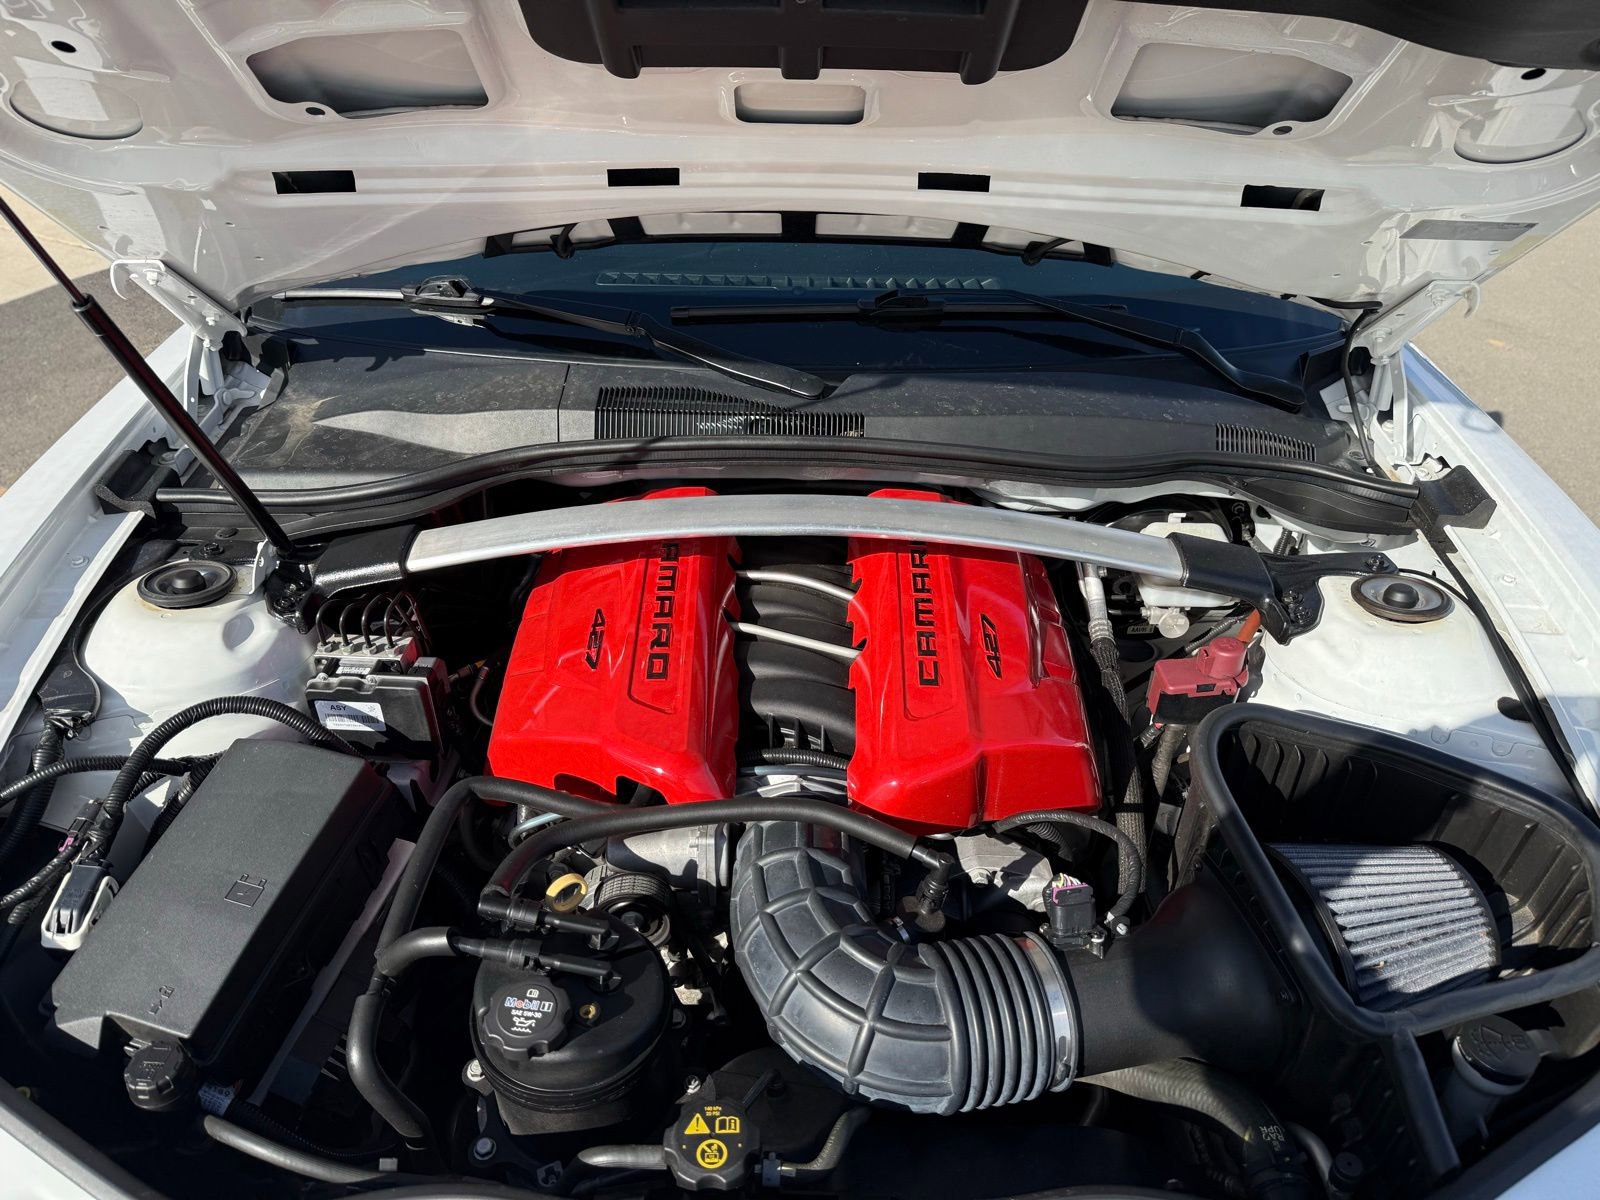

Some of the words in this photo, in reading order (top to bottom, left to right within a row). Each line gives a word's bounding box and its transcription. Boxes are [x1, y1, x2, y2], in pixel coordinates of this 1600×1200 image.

[585, 608, 606, 671] 427
[646, 543, 680, 680] AMARO
[909, 541, 939, 686] CAMAR
[980, 613, 1002, 679] 427
[504, 996, 540, 1010] Mobil
